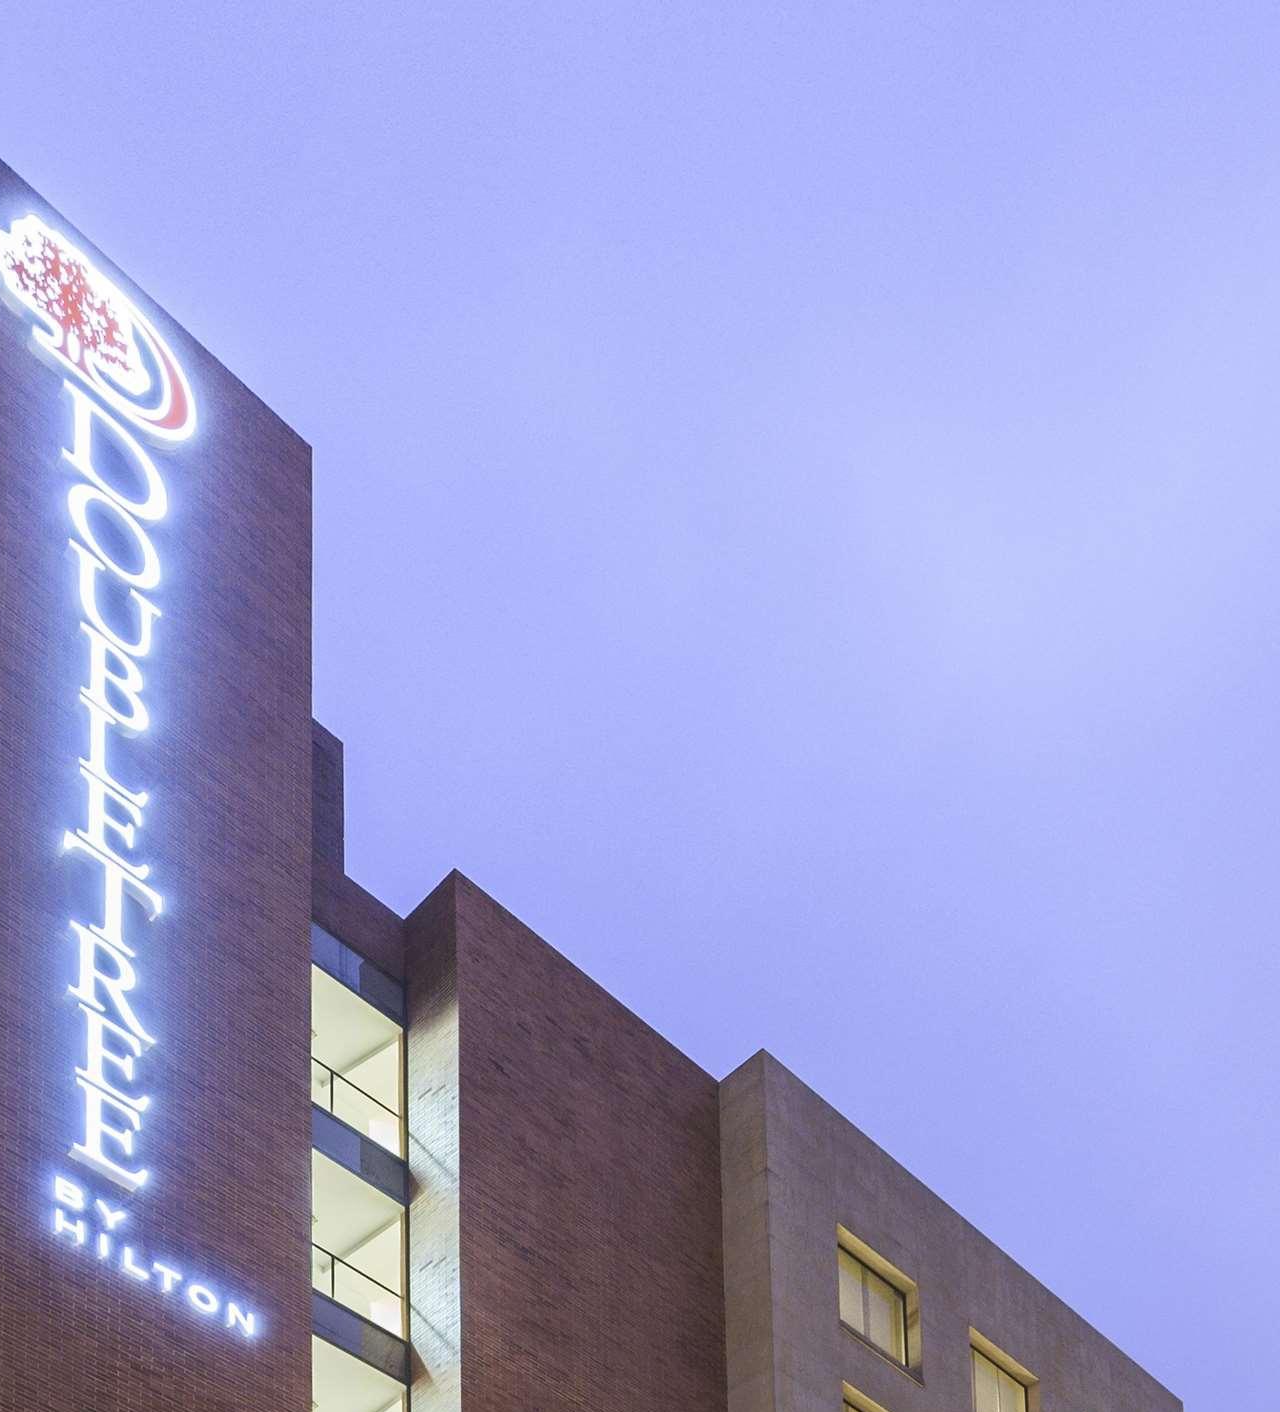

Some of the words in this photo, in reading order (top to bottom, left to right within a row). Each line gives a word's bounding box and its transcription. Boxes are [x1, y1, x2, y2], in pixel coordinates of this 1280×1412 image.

[61, 378, 168, 1187] DOUBLETREE
[54, 1175, 128, 1230] BY
[53, 1207, 256, 1338] HILTON
